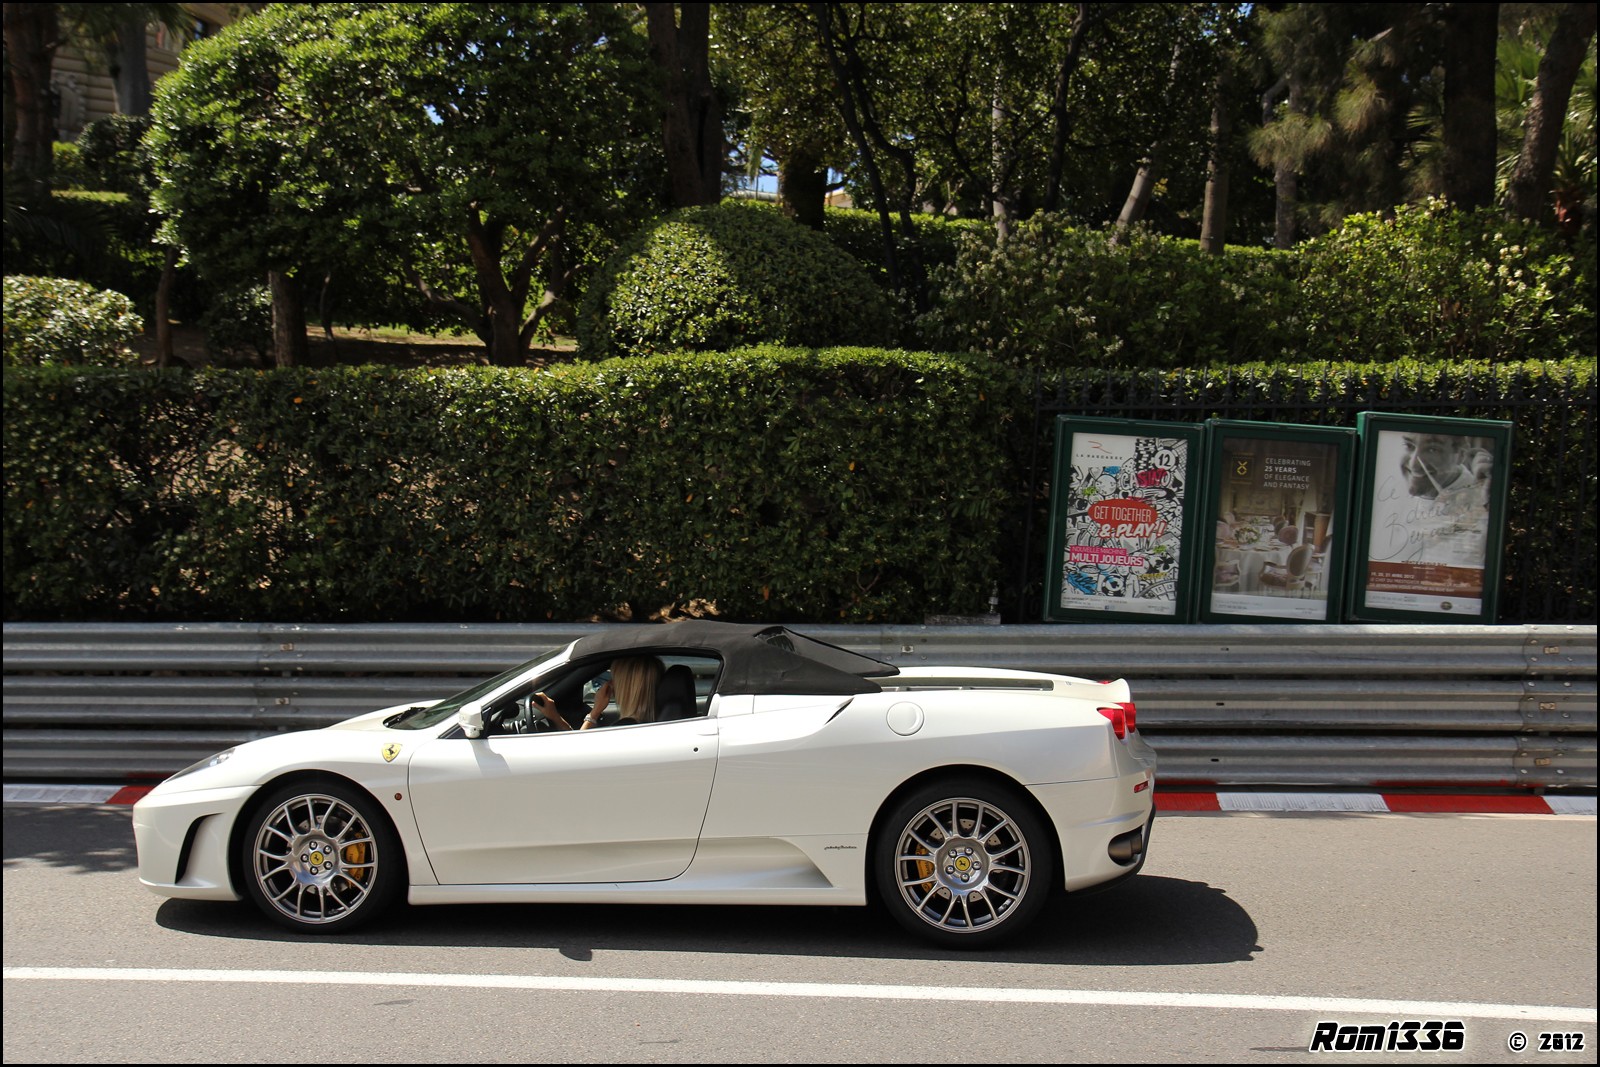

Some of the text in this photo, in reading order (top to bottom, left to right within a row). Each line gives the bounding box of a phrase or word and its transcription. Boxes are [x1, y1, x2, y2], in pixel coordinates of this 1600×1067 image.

[1158, 453, 1171, 467] 12
[1265, 458, 1310, 466] CELEBRATING
[1120, 468, 1171, 490] CASINO
[1275, 474, 1310, 482] ELEGANCE
[1279, 482, 1310, 490] FANTASY
[1094, 505, 1152, 522] GET TOGETHER
[1071, 545, 1101, 554] NOUVELLE
[1071, 553, 1143, 566] MULTI JOUEURS
